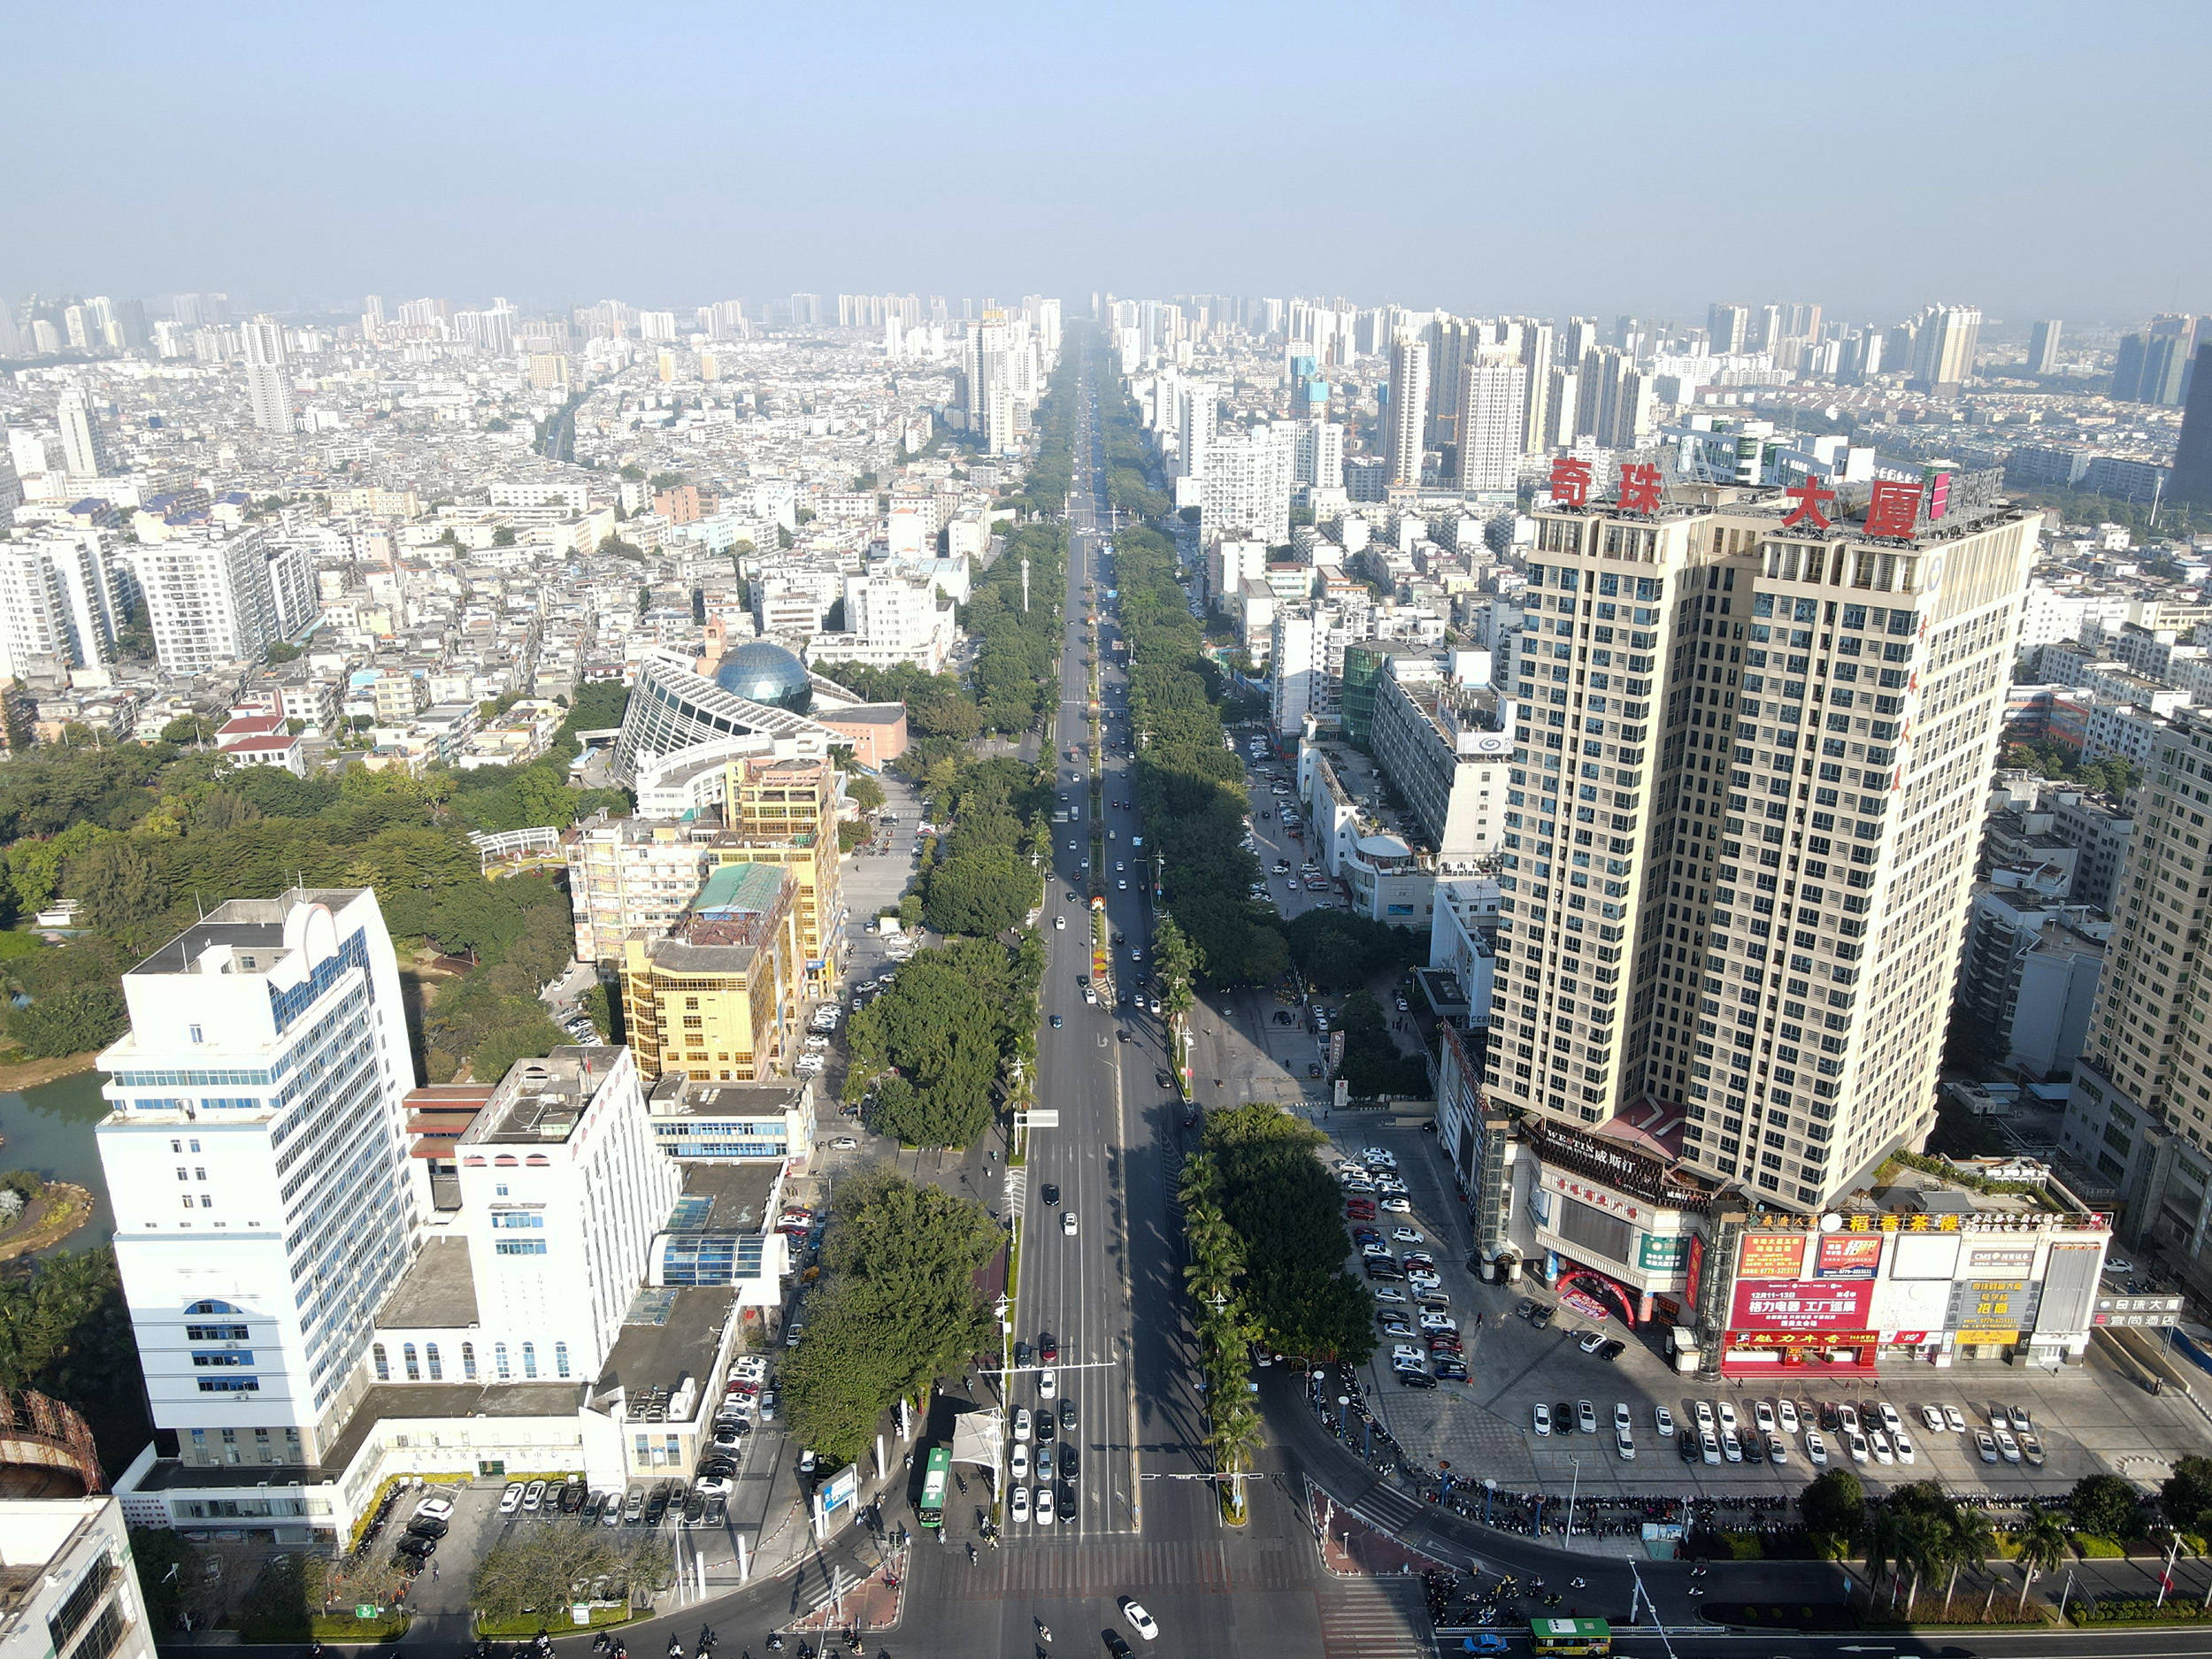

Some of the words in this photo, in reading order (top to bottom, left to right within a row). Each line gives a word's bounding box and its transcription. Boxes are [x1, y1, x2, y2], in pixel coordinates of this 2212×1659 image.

[1549, 457, 1924, 540] 奇珠大厦
[1547, 1129, 1594, 1152] WESTIN
[1594, 1149, 1635, 1173] 威斯汀
[1849, 1214, 1959, 1232] 稻香茶楼
[1748, 1301, 1801, 1313] 格力电器
[1803, 1301, 1856, 1313] 工厂巡展
[2116, 1299, 2179, 1310] 奇珠大厦
[2110, 1315, 2176, 1325] 宜尚酒店
